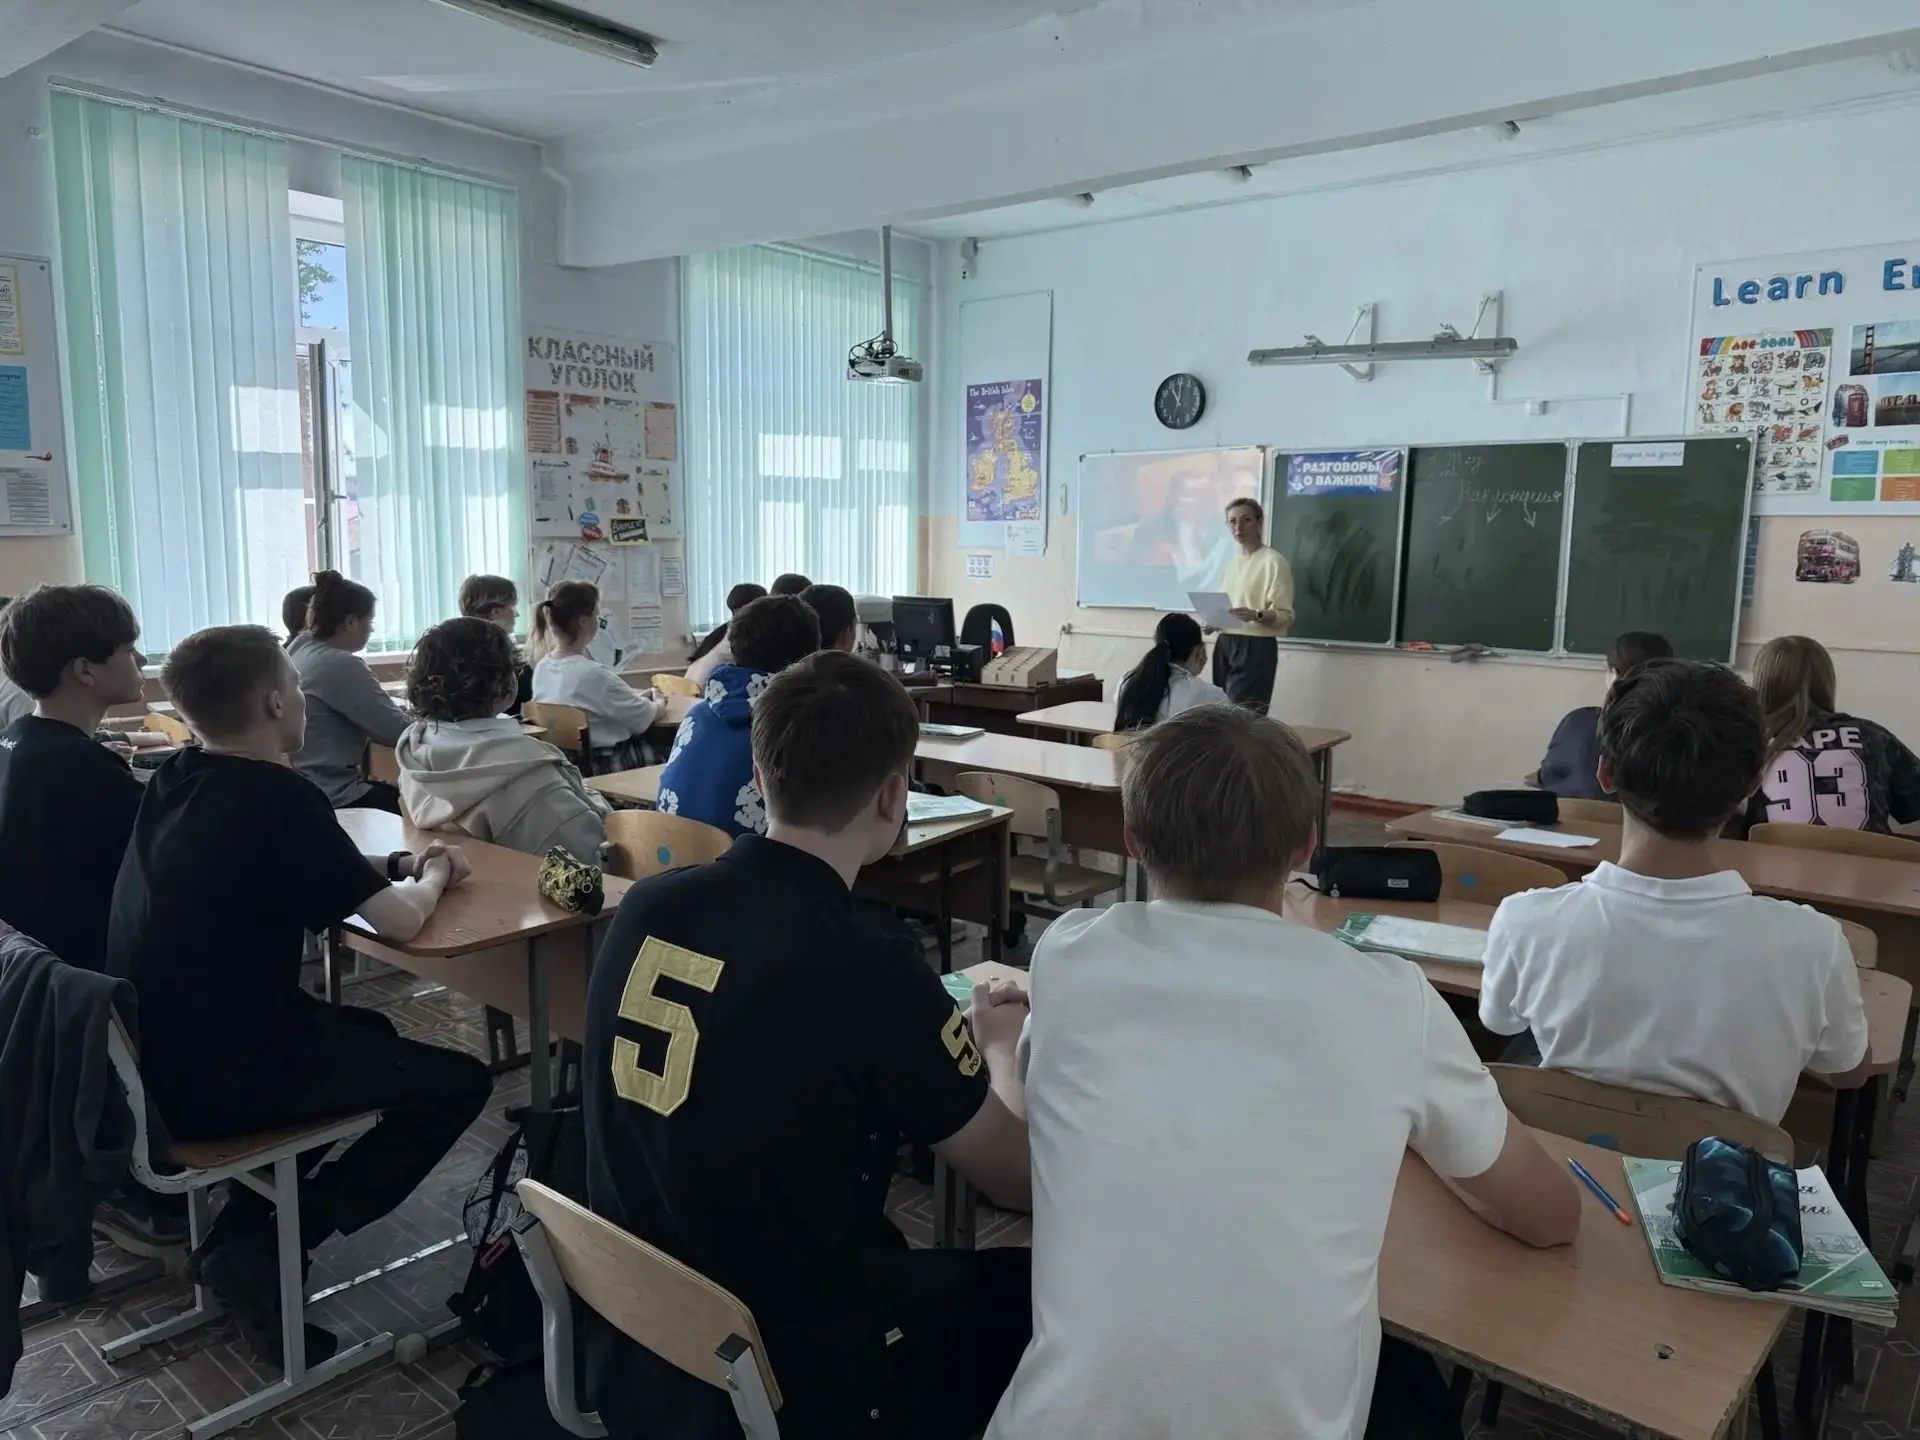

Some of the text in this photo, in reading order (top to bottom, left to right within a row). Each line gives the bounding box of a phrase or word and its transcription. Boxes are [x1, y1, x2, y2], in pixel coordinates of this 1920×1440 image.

[1713, 270, 1843, 307] Learn
[528, 336, 654, 372] КЛАССНЫЙ
[1793, 350, 1801, 358] D
[1803, 363, 1811, 371] E
[548, 362, 637, 393] УГОЛОК
[1726, 379, 1734, 387] G
[1749, 376, 1757, 385] H
[969, 388, 980, 397] The
[981, 385, 1001, 396] British
[1761, 403, 1771, 412] M
[1800, 397, 1809, 406] O
[1785, 446, 1793, 455] X
[1797, 446, 1805, 455] Y
[1303, 460, 1381, 474] РАЗГОВОРЫ
[1304, 474, 1378, 487] О ВАЖНОМ
[1761, 750, 1867, 831] 93
[612, 935, 725, 1117] 5
[941, 1004, 981, 1077] 5
